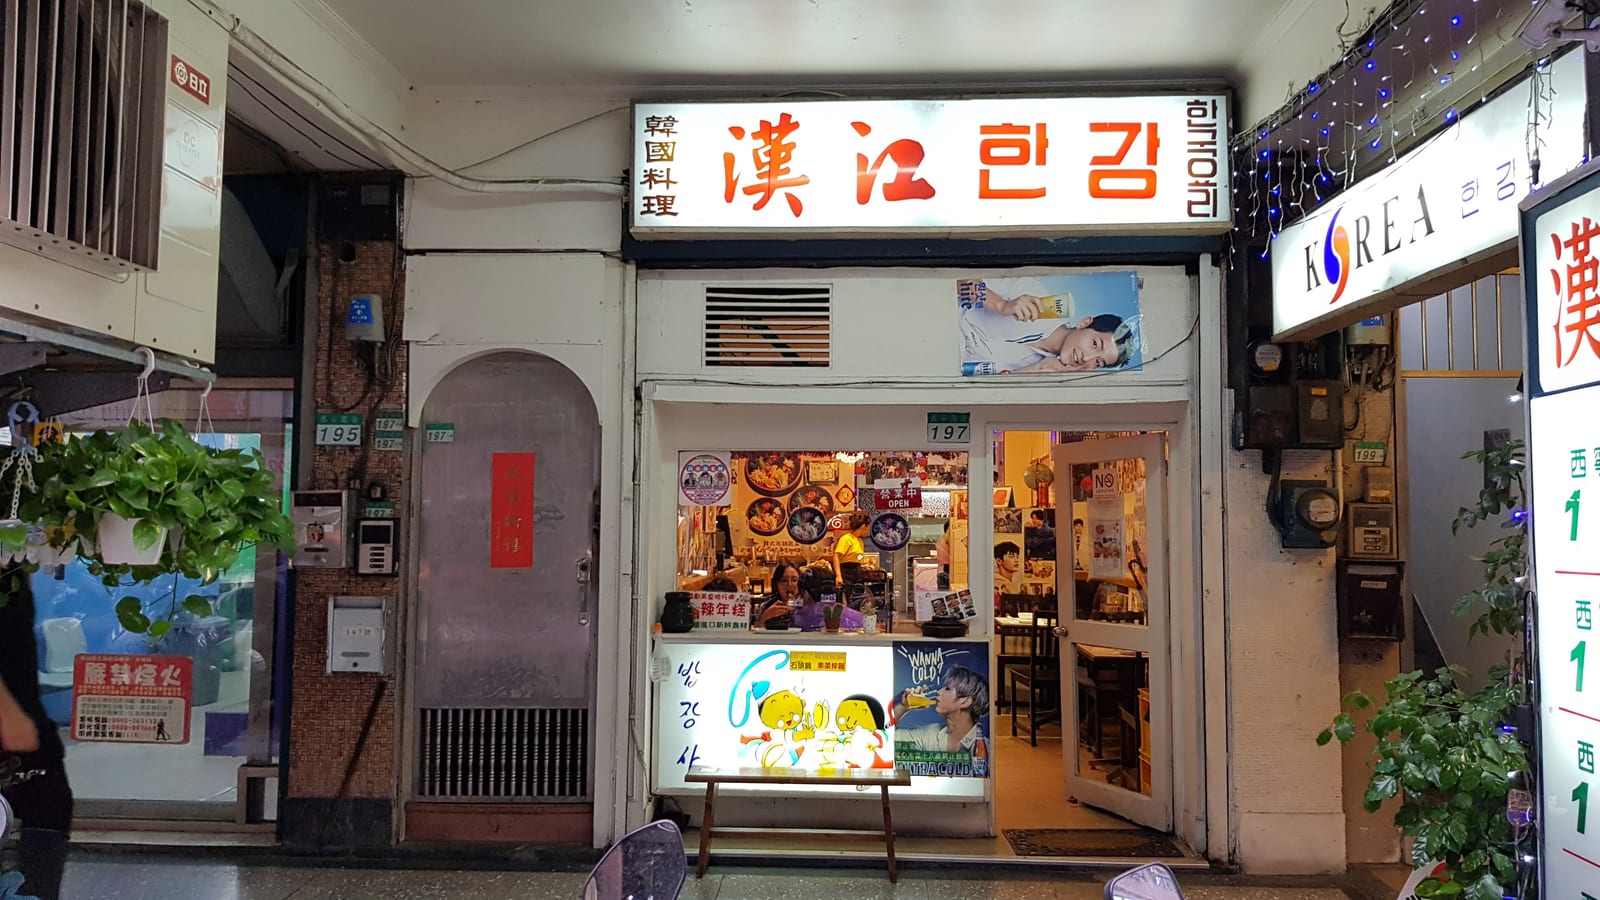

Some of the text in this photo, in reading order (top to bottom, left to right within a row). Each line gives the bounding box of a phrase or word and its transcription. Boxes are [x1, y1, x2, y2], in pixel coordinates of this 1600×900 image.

[189, 72, 208, 98] 日立
[639, 114, 679, 217] 韓國料理
[723, 112, 1161, 218] 漢江 한강
[1186, 99, 1218, 217] 한국요리
[1460, 157, 1516, 220] 한강
[1303, 183, 1435, 304] KOREA
[377, 420, 395, 429] 197
[932, 425, 968, 440] 197
[320, 427, 359, 442] 195
[428, 431, 446, 441] 197
[377, 439, 395, 449] 197
[1356, 449, 1377, 460] 199
[880, 487, 917, 500] 營業中
[888, 499, 909, 508] OPEN
[701, 602, 746, 617] 辣年糕
[1574, 600, 1591, 631] 西
[908, 648, 944, 667] WANNA
[86, 662, 181, 686] 嚴禁煙火
[1576, 739, 1594, 775] 西
[896, 761, 938, 776] EXTRA
[938, 761, 971, 777] COLD
